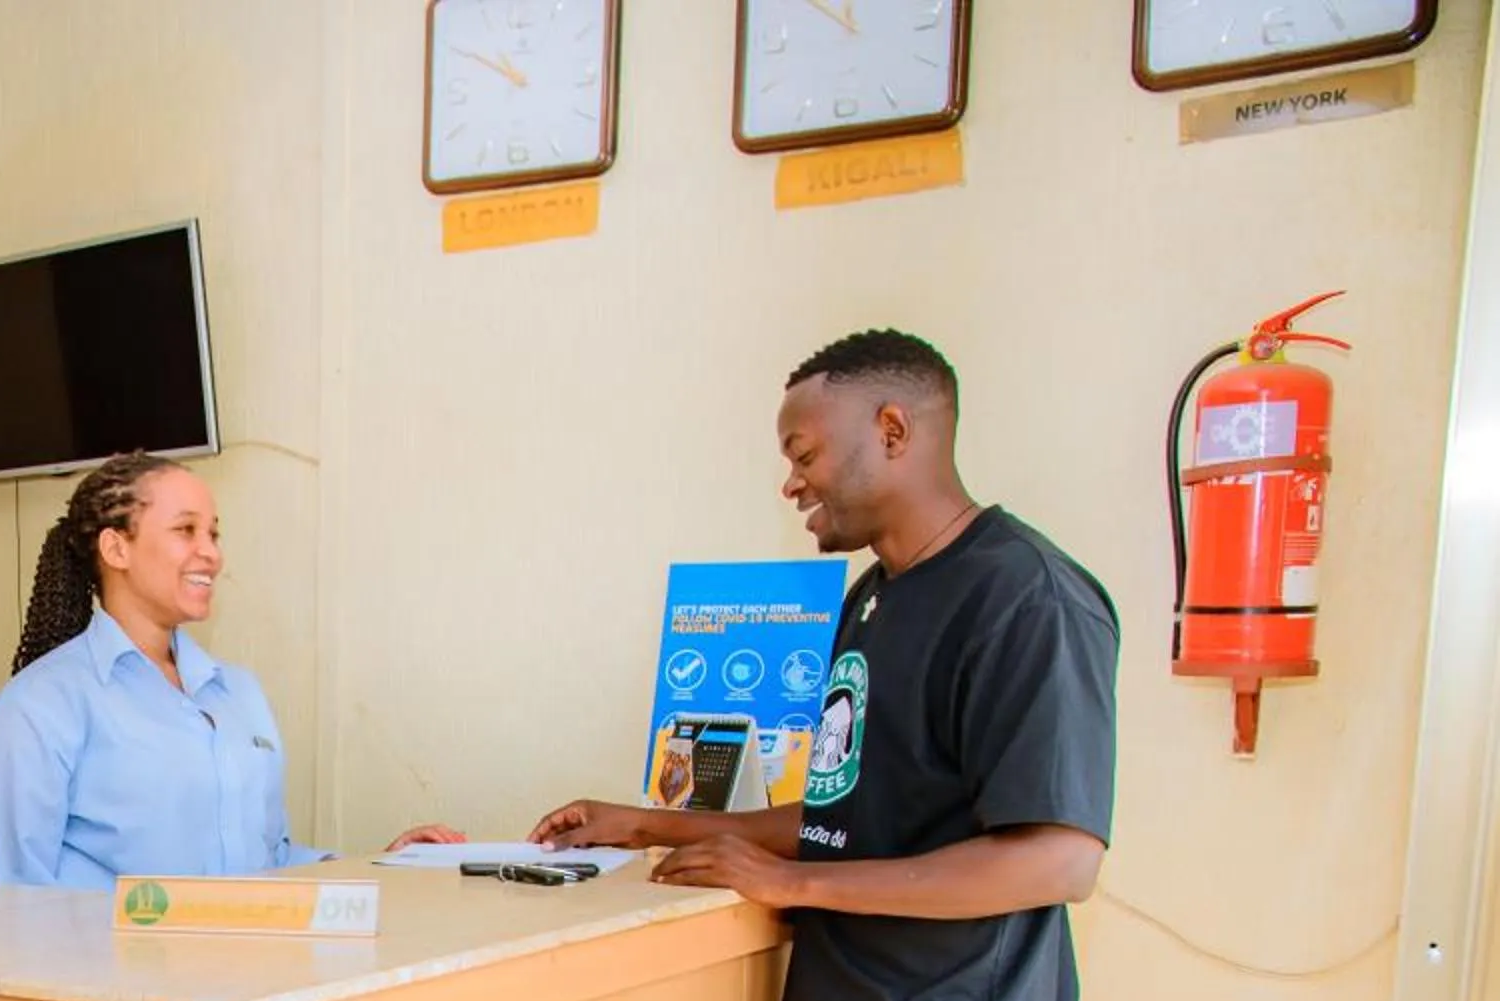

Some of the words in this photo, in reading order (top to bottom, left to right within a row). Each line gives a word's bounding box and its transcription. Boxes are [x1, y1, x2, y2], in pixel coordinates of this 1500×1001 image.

[1235, 98, 1284, 122] NEW
[1289, 88, 1348, 112] YORK
[807, 149, 930, 193] KIGALI
[699, 604, 740, 614] PROTECT
[769, 603, 802, 614] OTHER
[806, 769, 847, 796] FFEE
